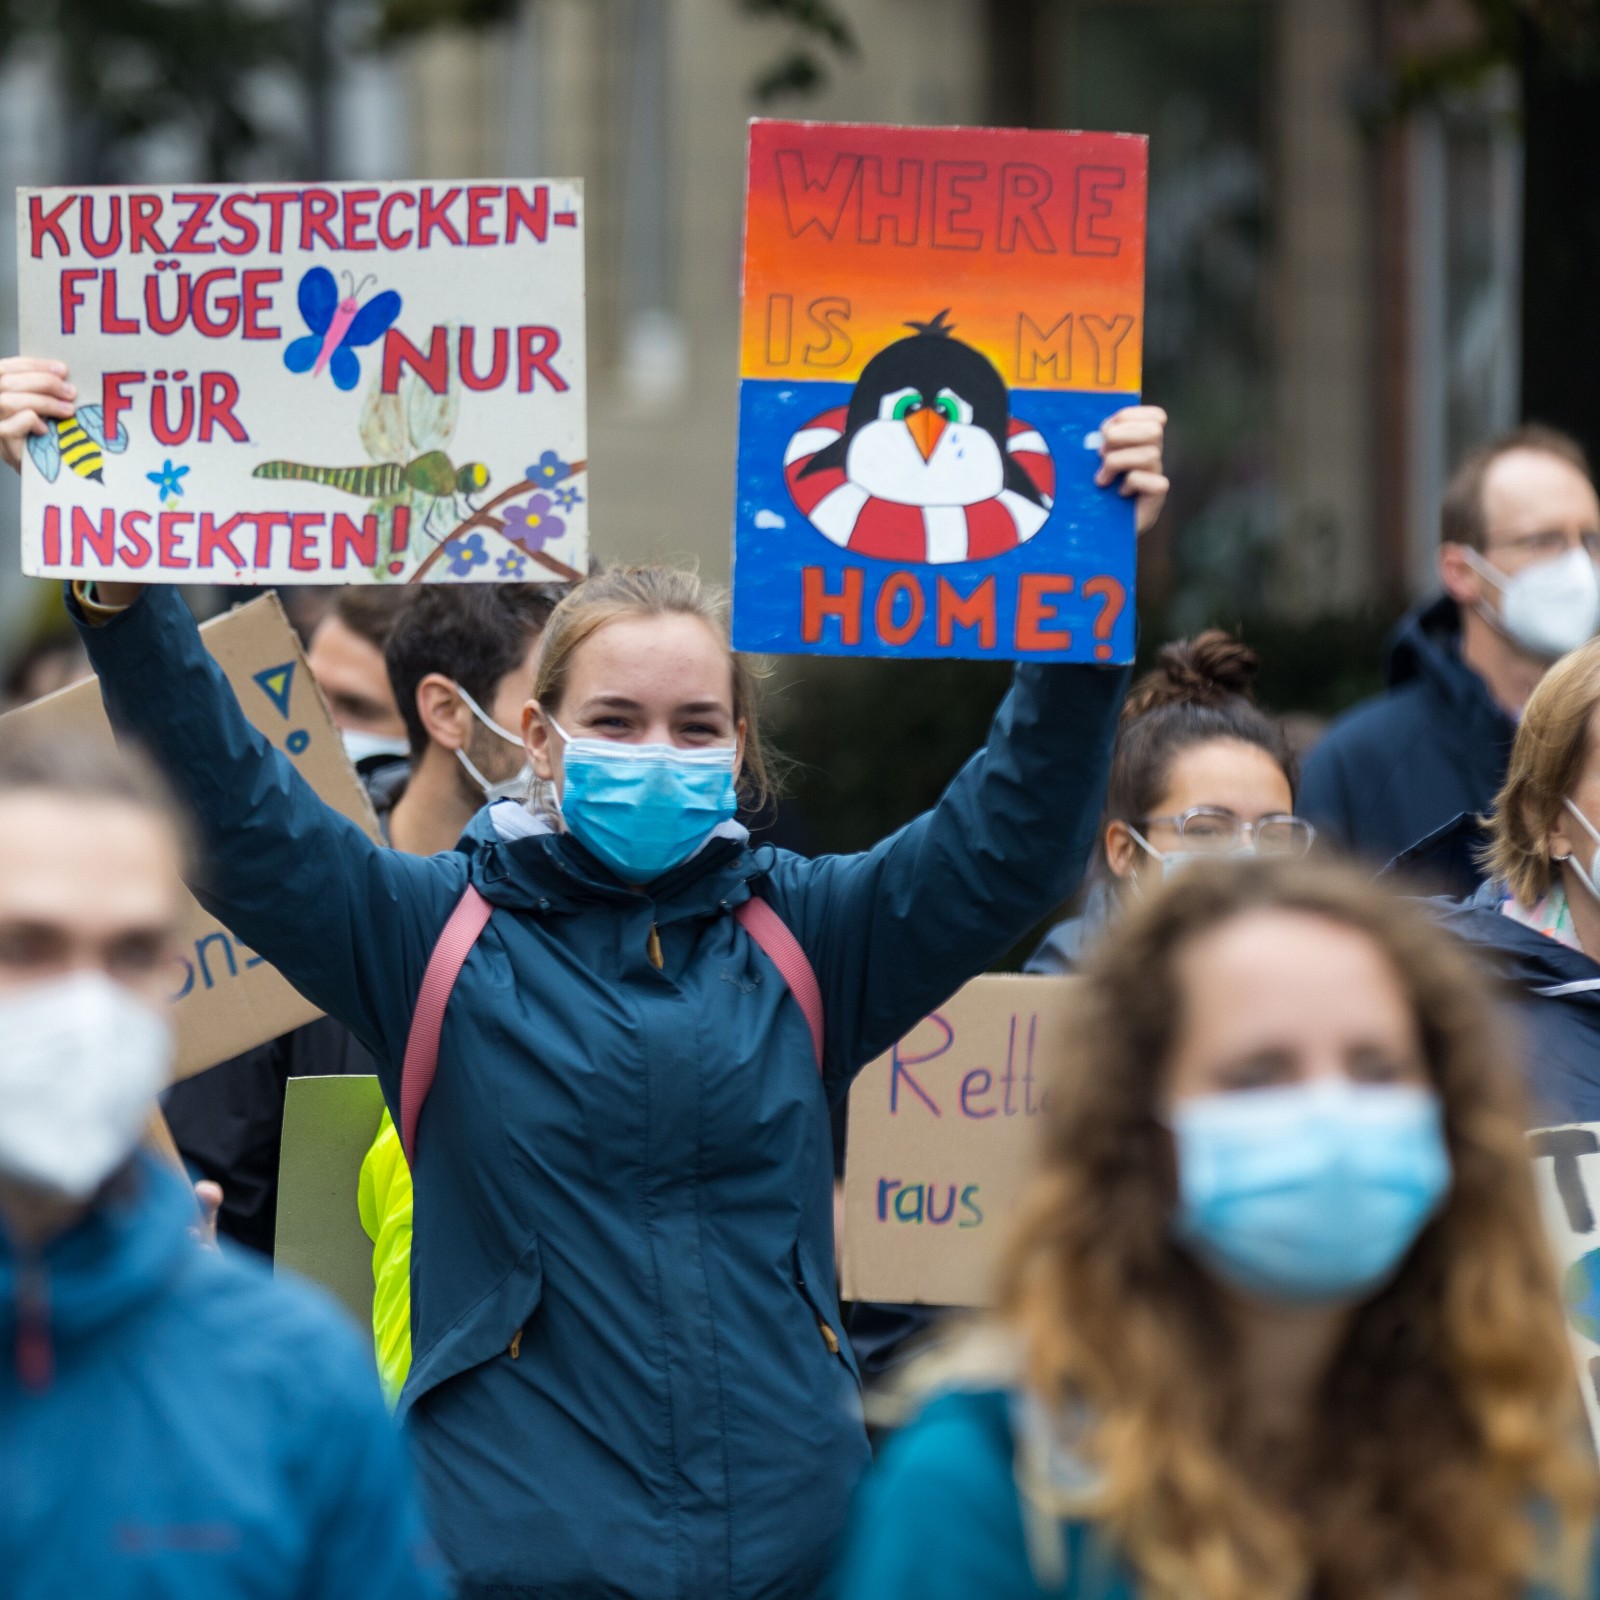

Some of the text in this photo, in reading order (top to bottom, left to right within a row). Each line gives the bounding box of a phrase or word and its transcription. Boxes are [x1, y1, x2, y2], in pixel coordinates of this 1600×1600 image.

[28, 186, 578, 259] KURZSTRECKEN-
[775, 149, 1127, 257] WHERE
[60, 260, 283, 339] FLÜGE
[381, 325, 569, 395] NUR
[764, 294, 1135, 385] IS MY
[101, 370, 250, 446] FÜR
[42, 505, 411, 575] INSEKTEN!
[801, 565, 1127, 660] HOME?
[889, 1011, 1051, 1119] Rett
[876, 1177, 985, 1229] raus
